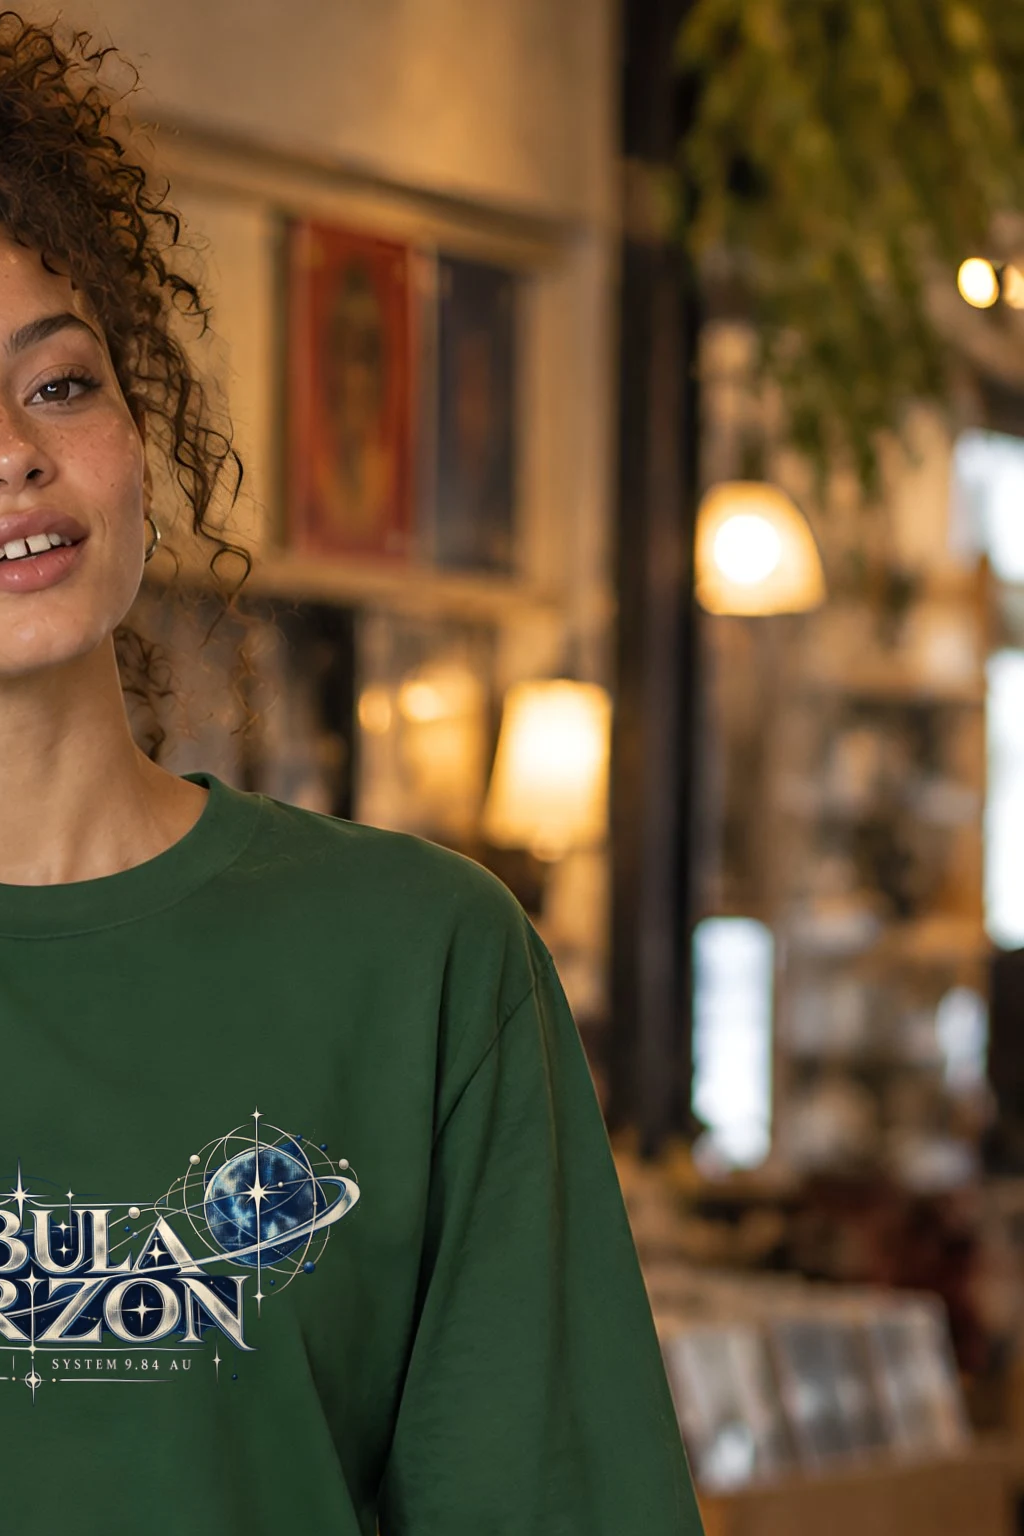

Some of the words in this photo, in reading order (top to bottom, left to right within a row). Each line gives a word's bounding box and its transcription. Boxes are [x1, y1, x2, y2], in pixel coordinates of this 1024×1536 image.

[51, 1358, 118, 1370] SYSTEM
[124, 1358, 160, 1371] 9.84
[169, 1359, 193, 1371] AU
